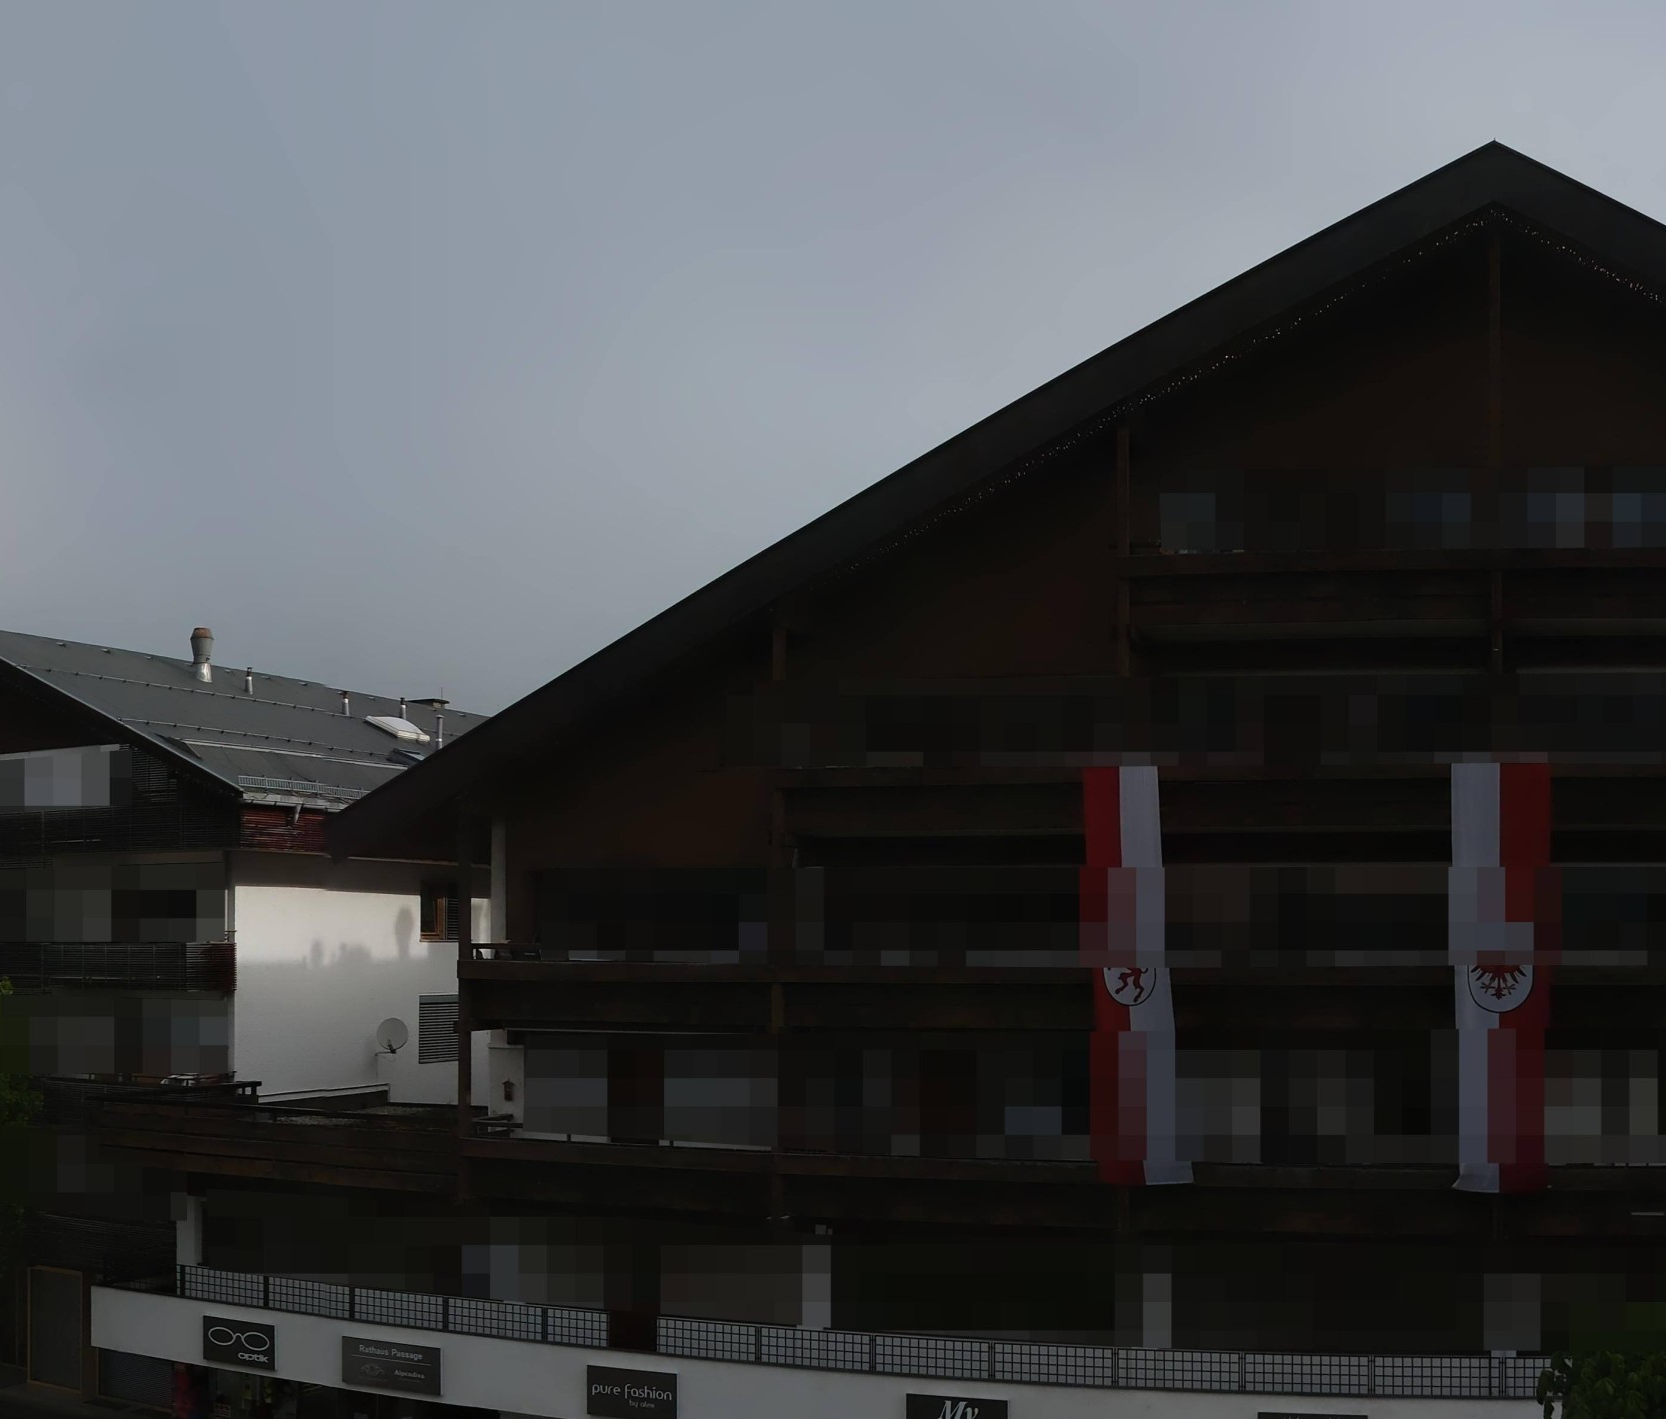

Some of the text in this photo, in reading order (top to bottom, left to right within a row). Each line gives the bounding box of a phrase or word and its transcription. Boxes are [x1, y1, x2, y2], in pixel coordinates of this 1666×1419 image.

[237, 1350, 270, 1364] optik
[358, 1343, 424, 1362] Rathaus Passage
[591, 1382, 672, 1401] pure fashion
